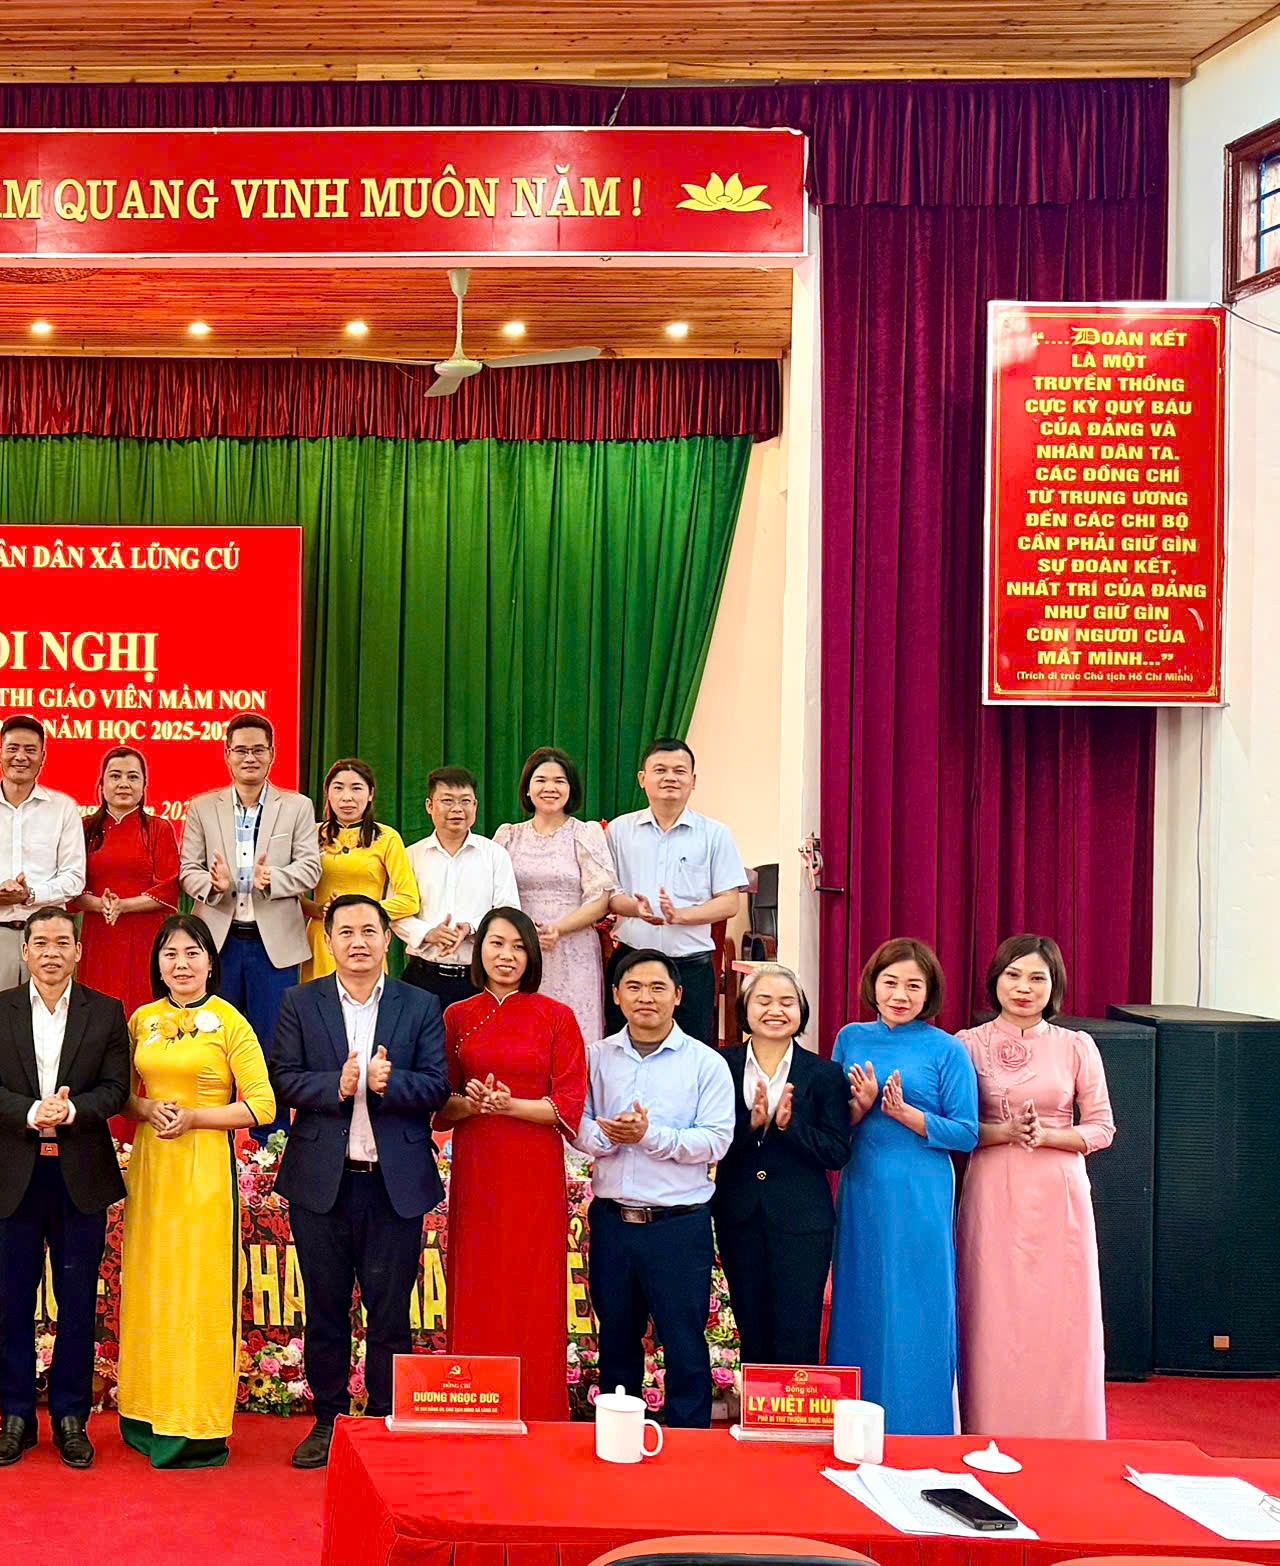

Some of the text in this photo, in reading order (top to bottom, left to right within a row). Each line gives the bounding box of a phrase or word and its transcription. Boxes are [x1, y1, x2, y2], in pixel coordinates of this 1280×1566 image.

[54, 179, 217, 222] QUANG
[232, 179, 349, 218] VINH
[361, 165, 499, 217] MUÔN
[513, 168, 620, 216] NĂM
[633, 179, 640, 216] !
[1150, 329, 1187, 346] KẾT
[1072, 352, 1145, 371] LÀ MỘT
[1033, 373, 1184, 391] TRUYỀN THỐNG
[1026, 399, 1191, 415] CỰC KỲ QUÝ BÁU
[1041, 417, 1176, 436] CỦA ĐẢNG VÀ
[1037, 443, 1179, 460] NHÂN DÂN TA.
[1036, 464, 1179, 482] CÁC ĐỒNG CHÍ
[1030, 487, 1187, 505] TỪ TRUNG ƯƠNG
[1026, 510, 1188, 531] ĐẾN CÁC CHI BỘ
[1018, 533, 1196, 552] CẦN PHẢI GIỮ GÌN
[33, 540, 84, 568] DÂN
[90, 542, 124, 568] XÃ
[130, 542, 199, 569] LŨNG
[206, 542, 240, 569] CÚ
[1038, 557, 1176, 575] SỰ ĐOÀN KẾT,
[1007, 578, 1206, 597] NHẤT TRÍ CỦA ĐẢNG
[1045, 603, 1168, 620] NHƯ GIỮ GÌN
[1027, 628, 1068, 642] CON
[1145, 625, 1185, 642] CỦA
[39, 632, 158, 682] NGHỊ
[39, 683, 95, 708] GIÁO
[100, 684, 152, 708] VIÊN
[159, 684, 212, 709] MẦM
[220, 690, 265, 709] NON
[44, 715, 92, 739] NĂM
[99, 720, 145, 744] HỌC
[414, 1392, 447, 1402] DƯƠNG
[450, 1392, 477, 1404] NGỌC
[748, 1396, 765, 1411] LY
[770, 1394, 804, 1416] VIỆT
